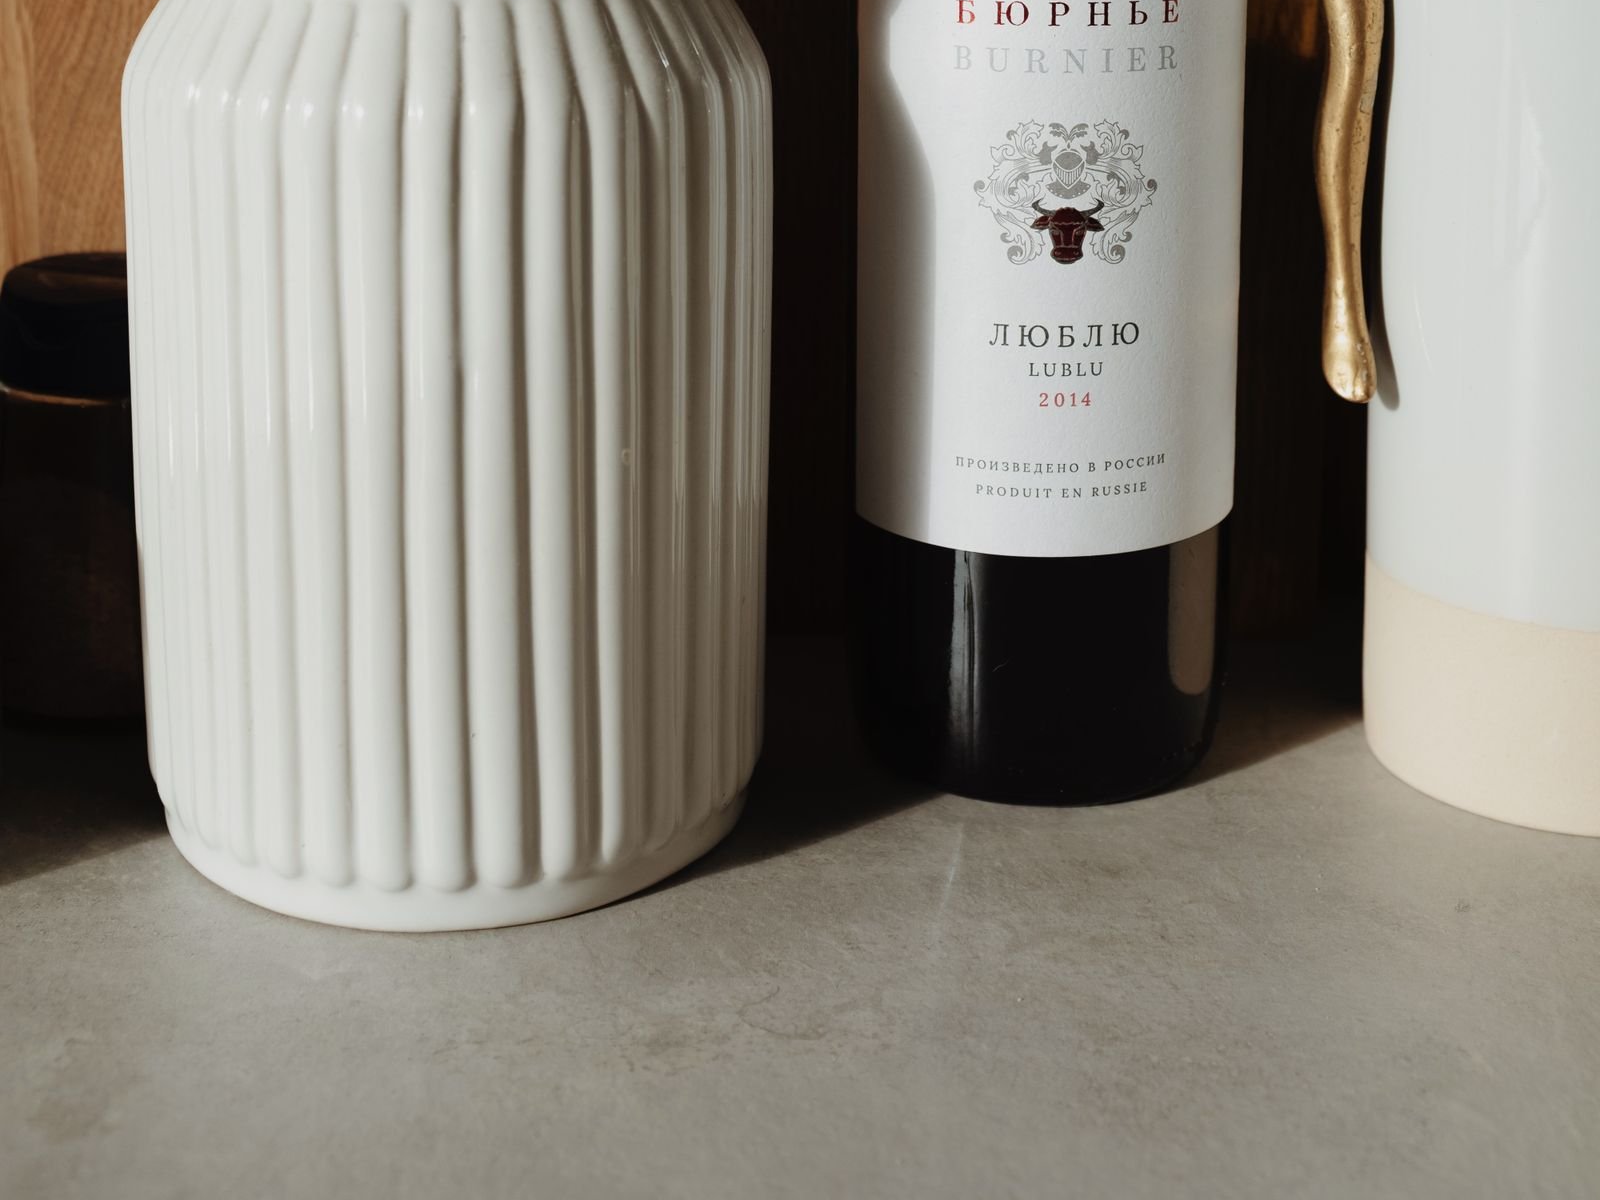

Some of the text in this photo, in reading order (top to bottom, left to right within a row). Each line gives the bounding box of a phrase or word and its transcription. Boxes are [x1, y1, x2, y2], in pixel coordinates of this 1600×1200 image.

[953, 44, 1178, 74] BURNIER
[988, 321, 1141, 348] ЛЮБЛЮ
[1028, 361, 1104, 377] LUBLU
[1038, 391, 1092, 408] 2014
[955, 452, 1166, 475] ПРОИЗВЕДЕНО В РОССИИ
[975, 480, 1148, 499] PRODUIT EN RUSSIE
